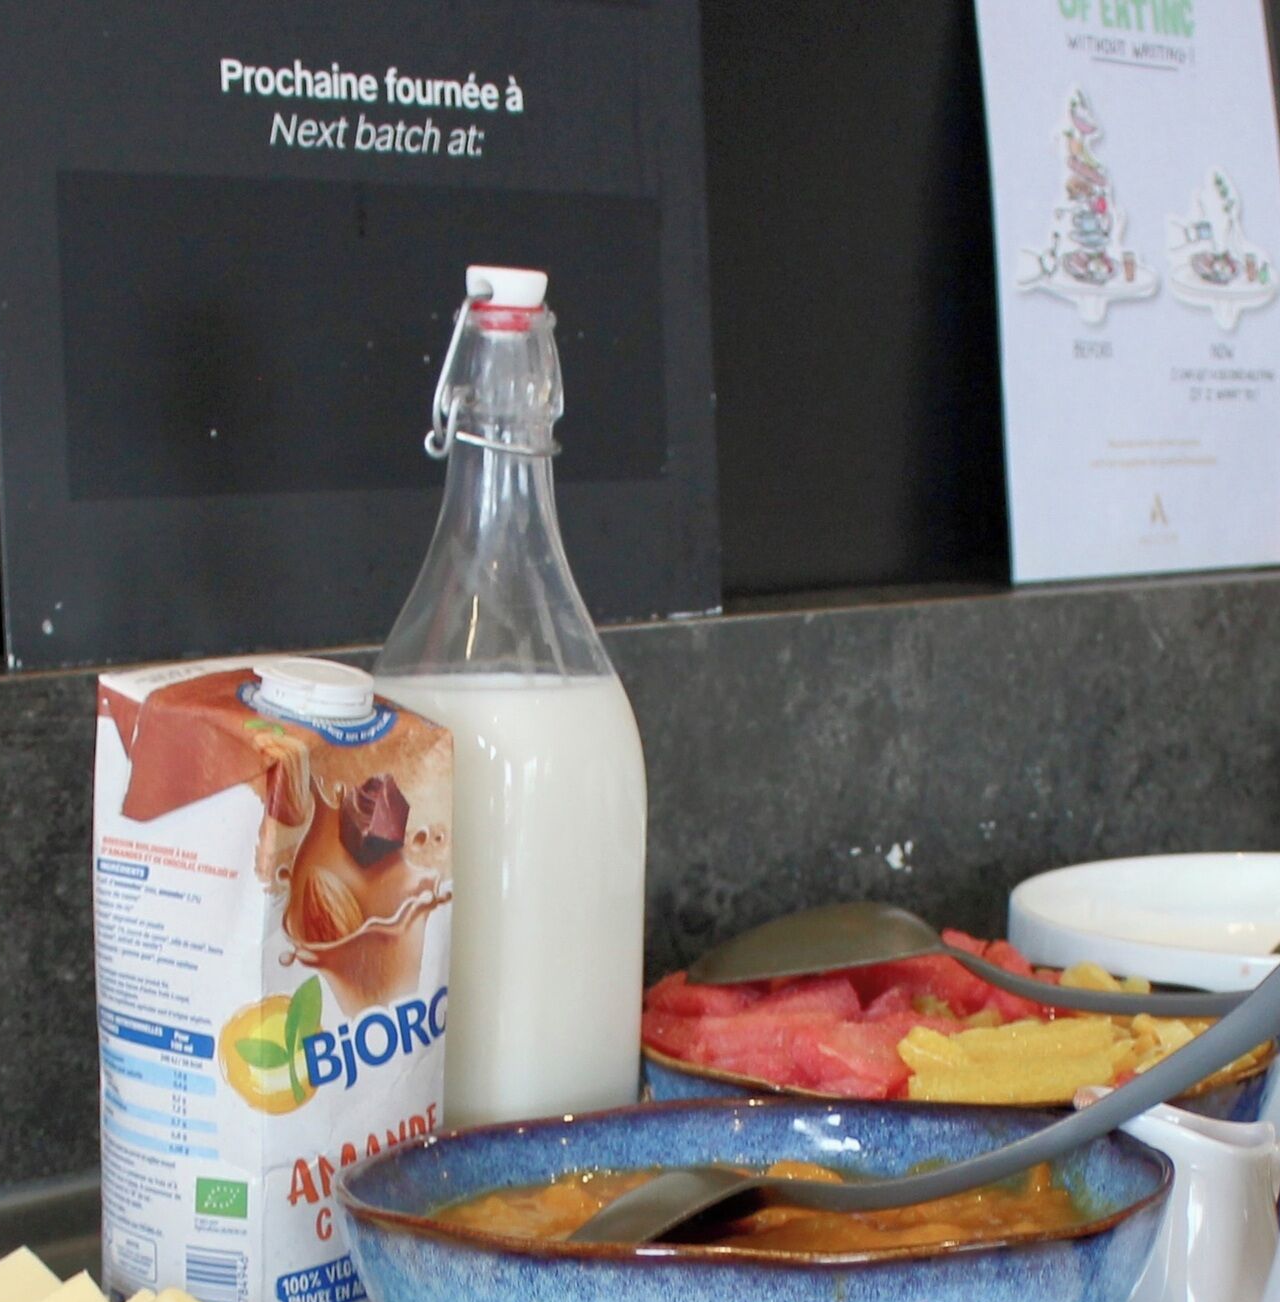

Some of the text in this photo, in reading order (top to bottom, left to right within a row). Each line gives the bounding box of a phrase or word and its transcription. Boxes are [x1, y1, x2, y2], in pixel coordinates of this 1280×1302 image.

[220, 58, 524, 113] Prochaine fournée à
[269, 112, 486, 157] Next batch at:
[282, 1269, 322, 1296] 100%
